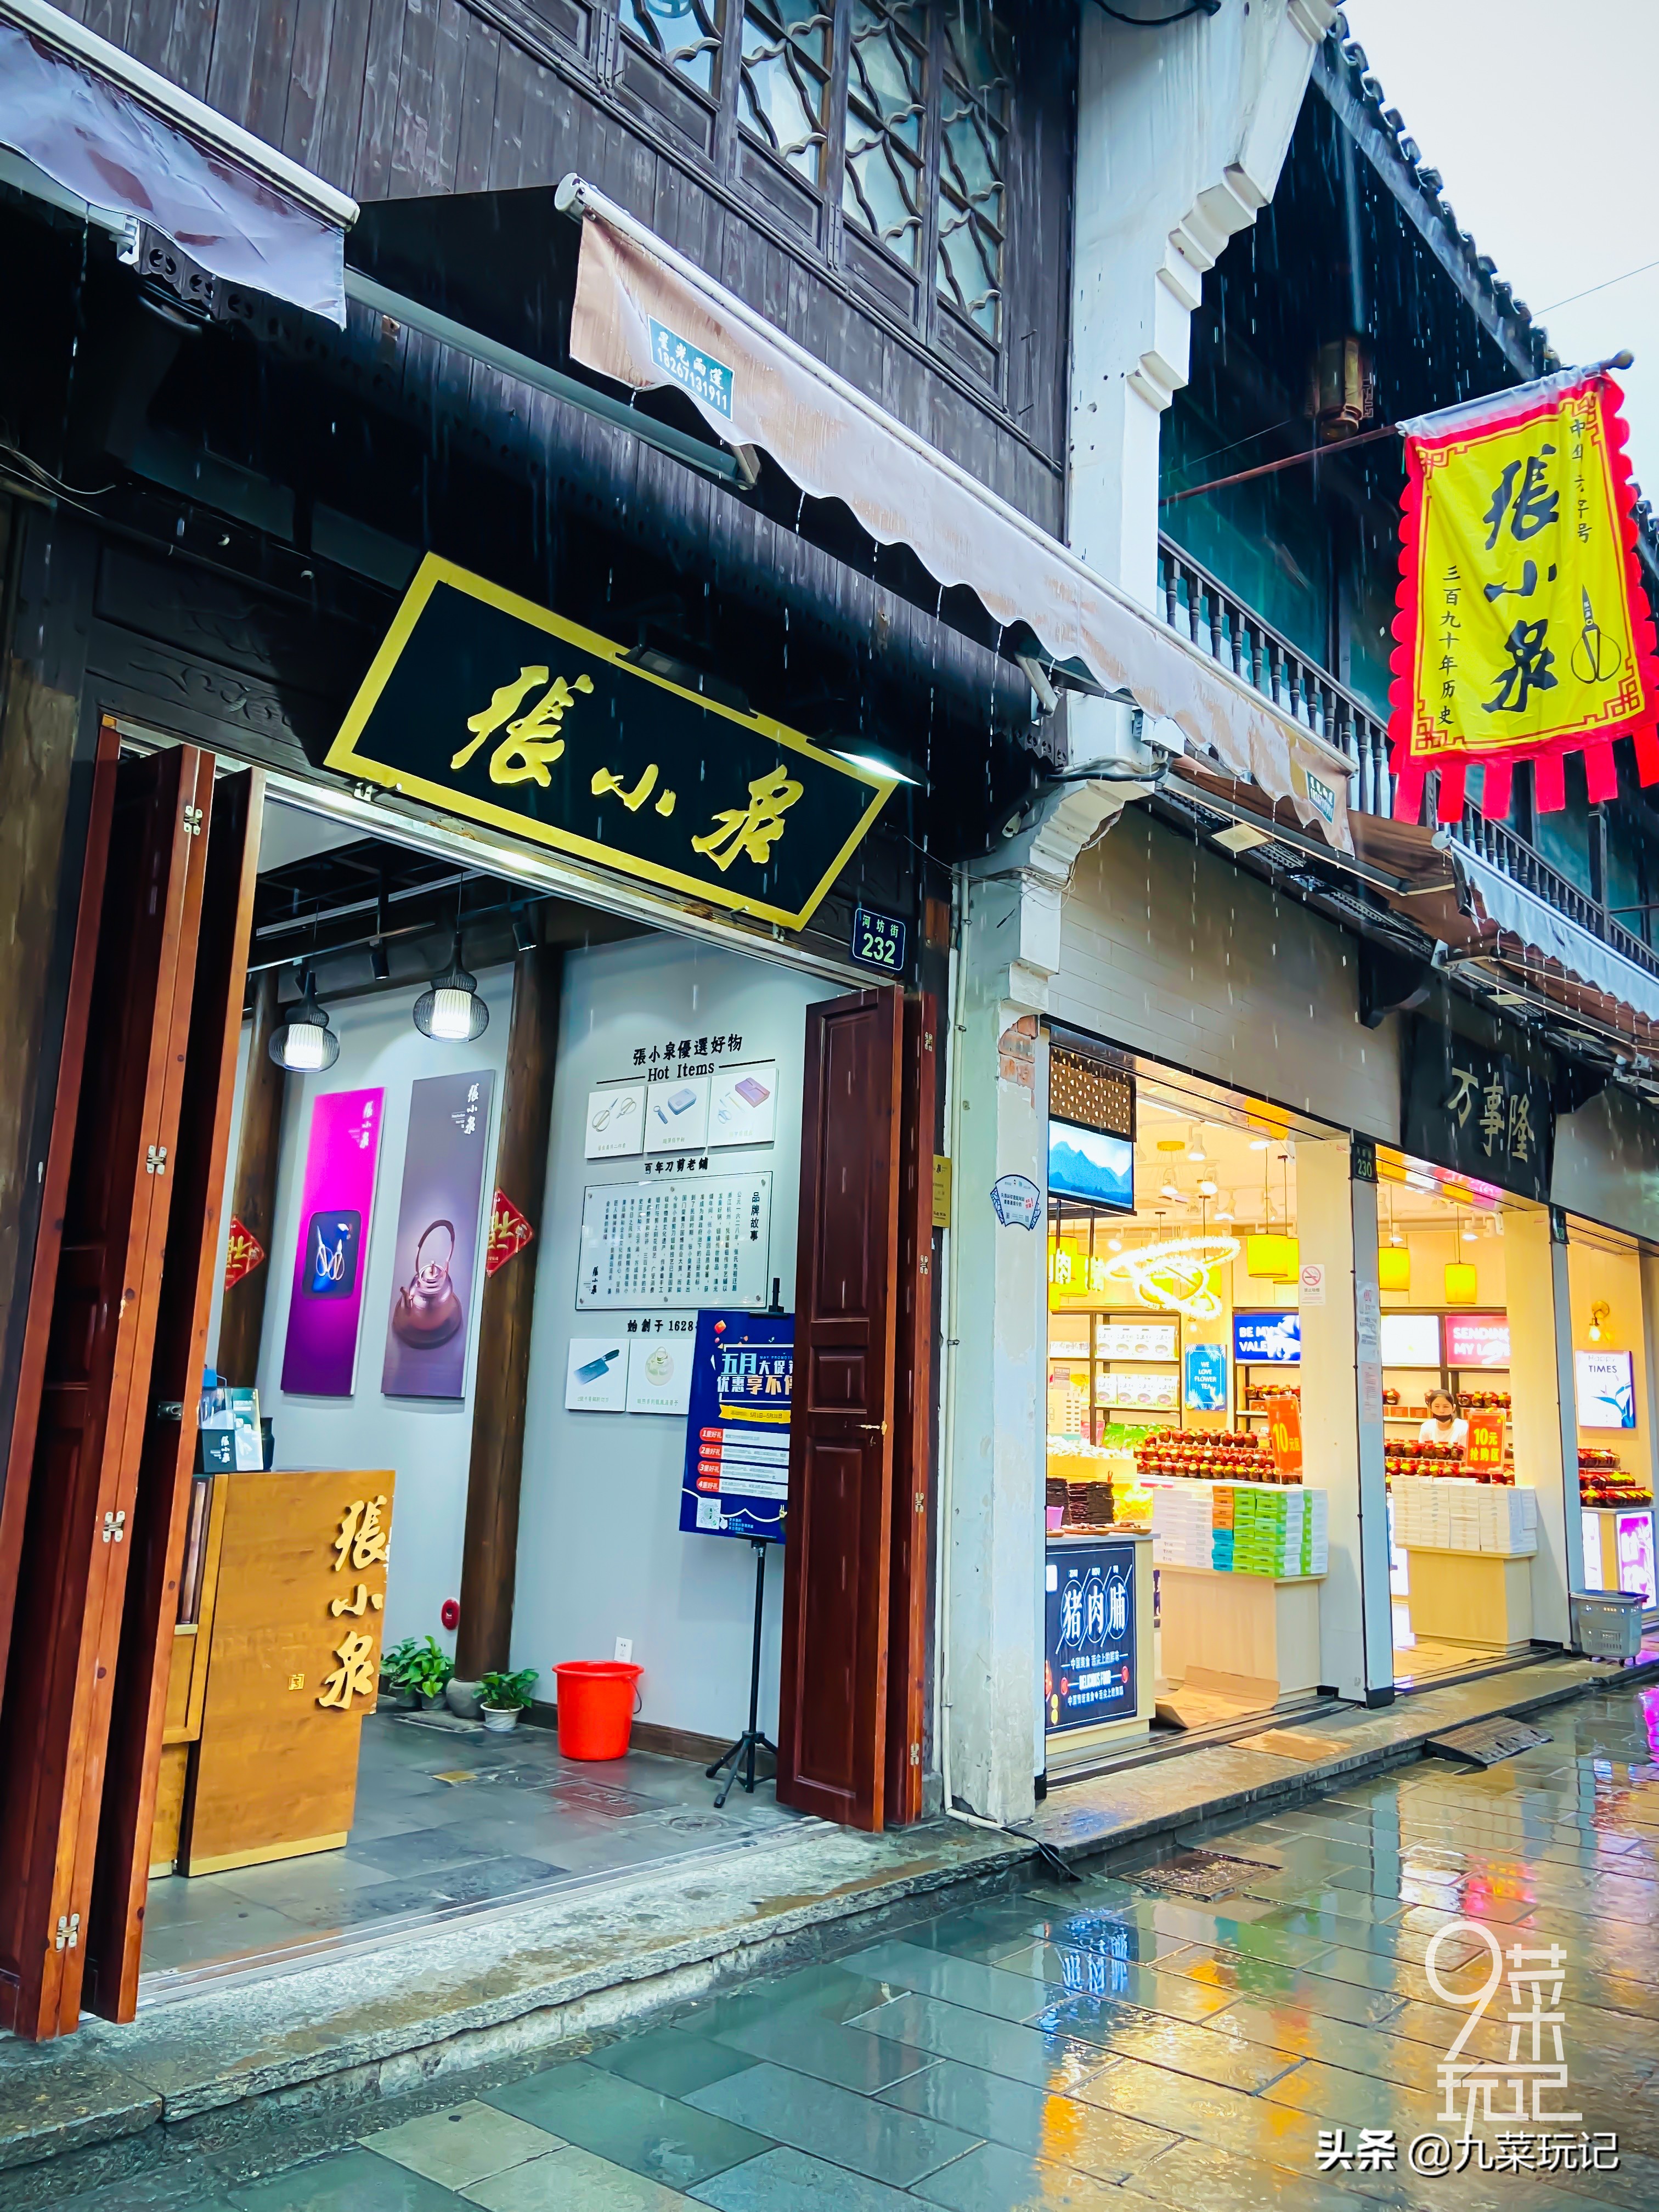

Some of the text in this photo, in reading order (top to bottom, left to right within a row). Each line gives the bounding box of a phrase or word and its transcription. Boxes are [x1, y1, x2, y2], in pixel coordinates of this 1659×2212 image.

[657, 347, 727, 410] 18267131911
[1438, 565, 1461, 725] 三百九十年历史
[450, 665, 804, 871] 張小泉
[862, 914, 899, 938] 河坊街
[861, 932, 896, 964] 232
[632, 1032, 743, 1066] 張小泉優選好物
[647, 1062, 715, 1082] Hot Items
[1357, 1158, 1372, 1178] 230
[750, 1192, 760, 1242] 品牌故事
[627, 1318, 698, 1333] 始創于1628
[1239, 1326, 1254, 1338] BE
[1454, 1342, 1475, 1355] MY
[1588, 1365, 1617, 1374] TIMES
[1474, 1427, 1498, 1446] 10元
[319, 1494, 388, 1709] 張小泉
[1062, 1582, 1127, 1639] 猪肉脯
